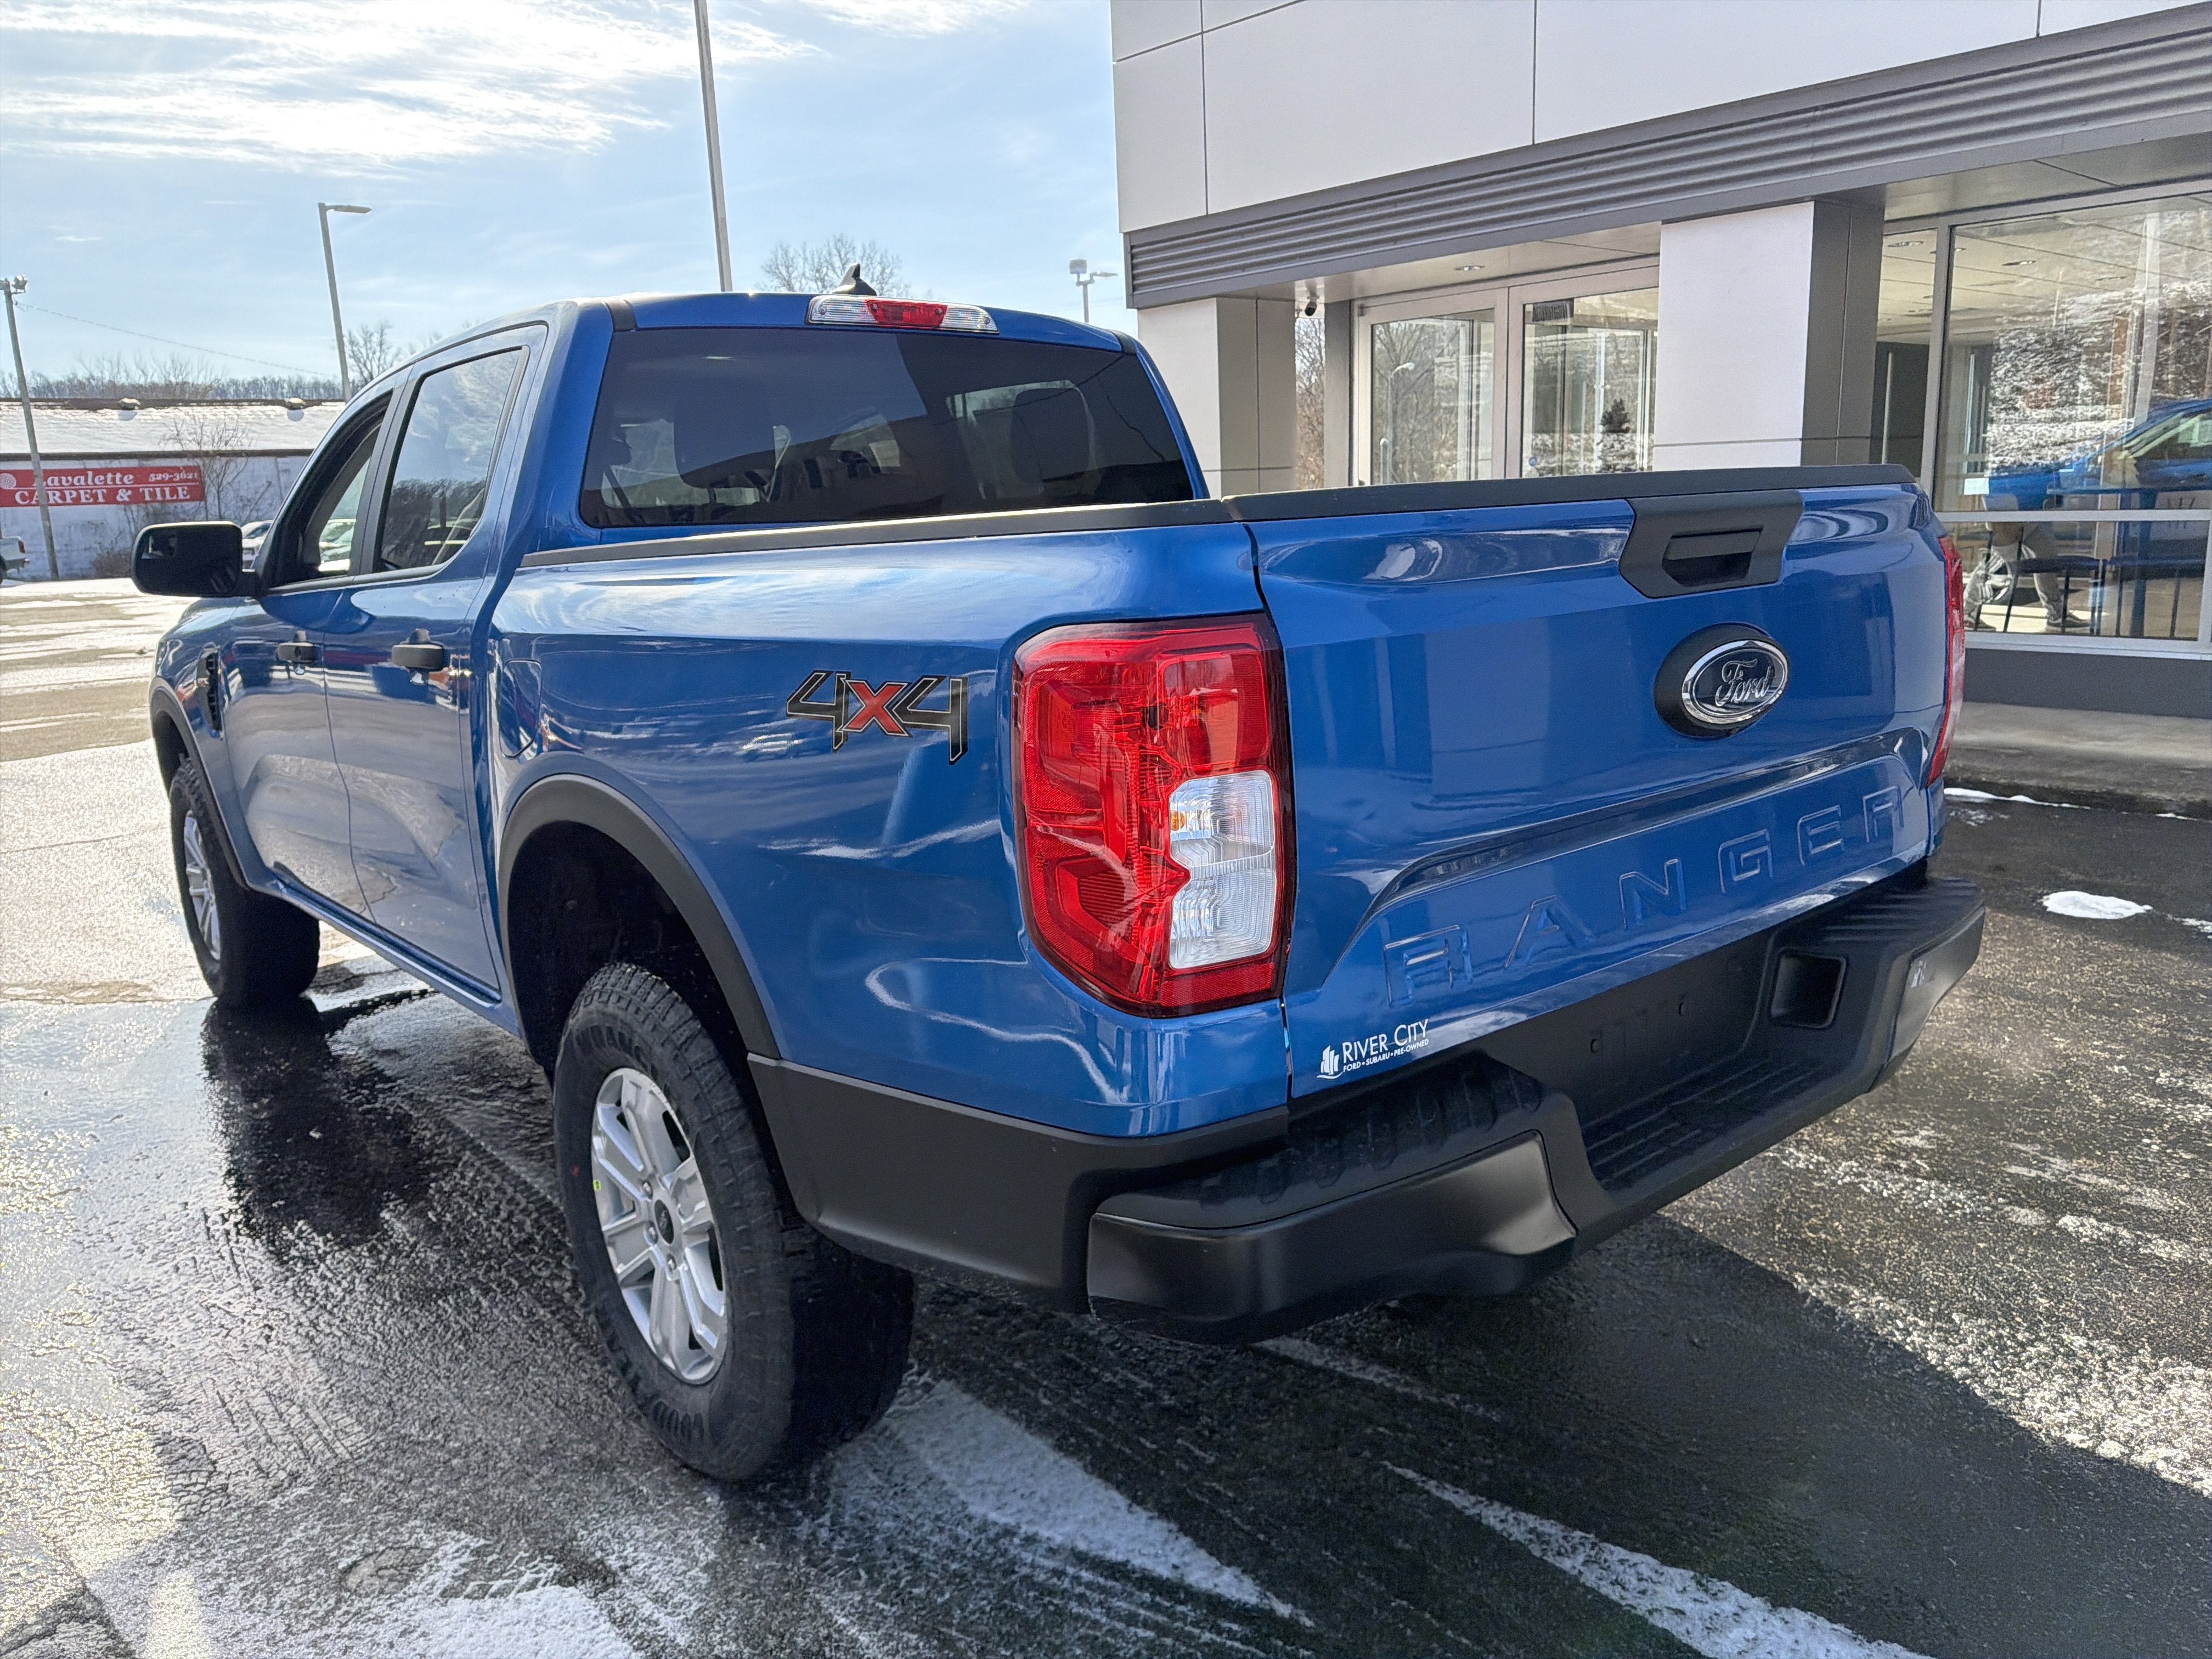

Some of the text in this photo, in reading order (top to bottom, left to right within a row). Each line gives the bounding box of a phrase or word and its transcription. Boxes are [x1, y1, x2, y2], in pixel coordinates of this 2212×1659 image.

[32, 471, 134, 487] avalette
[116, 488, 132, 501] &
[139, 486, 190, 501] TILE
[1715, 658, 1774, 707] Ford
[1383, 785, 1906, 1007] RANGER
[1342, 1018, 1429, 1063] RIVER CITY
[1343, 1038, 1429, 1073] FORD SUBARU PRE-OWNED
